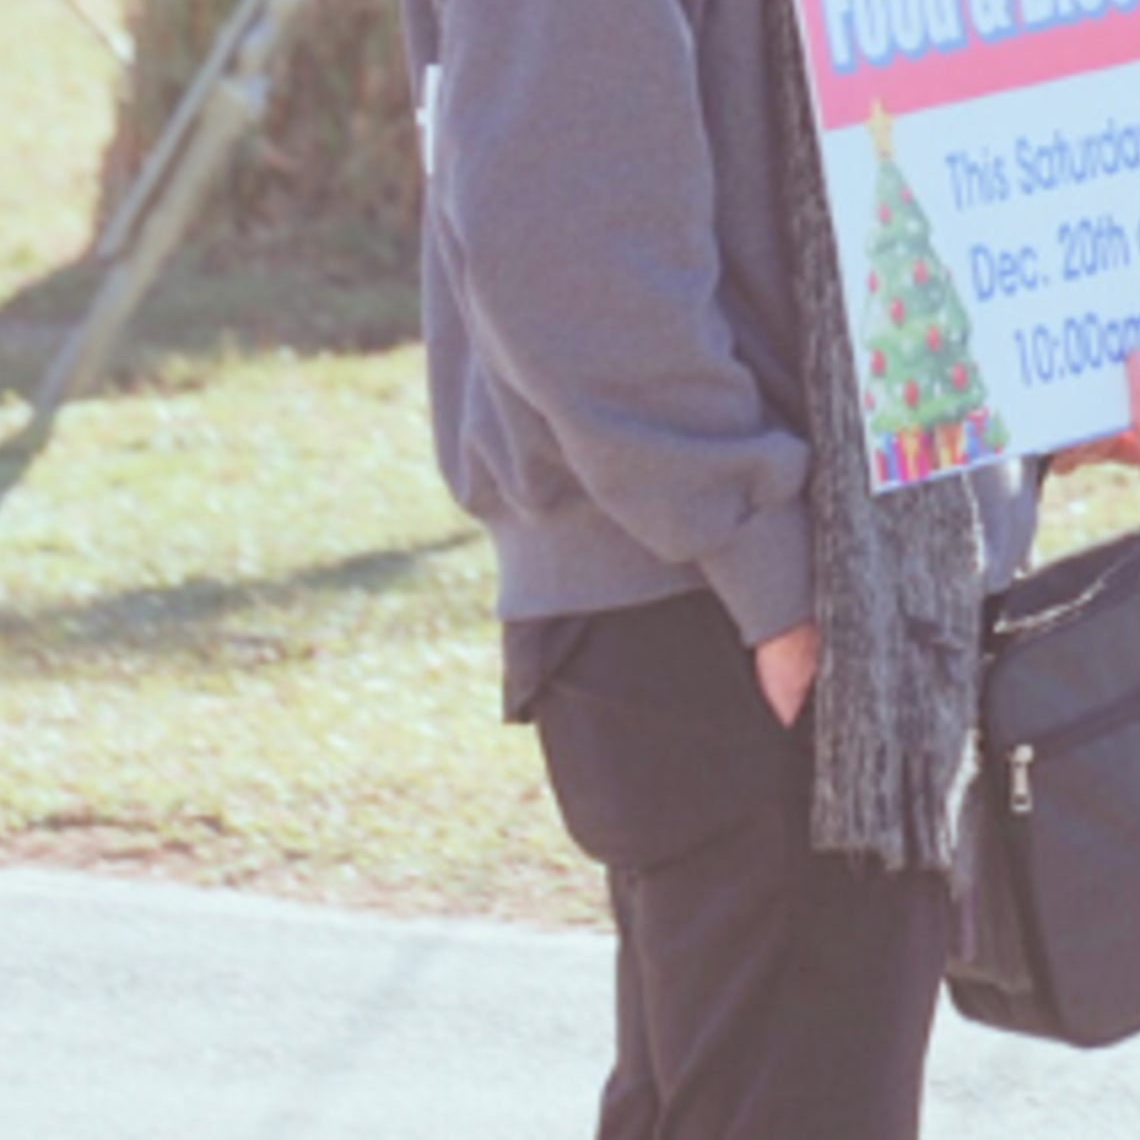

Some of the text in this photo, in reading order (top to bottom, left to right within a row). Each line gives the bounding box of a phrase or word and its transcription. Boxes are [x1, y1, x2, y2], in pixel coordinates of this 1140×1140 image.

[945, 149, 1010, 211] This
[969, 242, 1051, 302] Dec.
[1057, 215, 1131, 281] 20th
